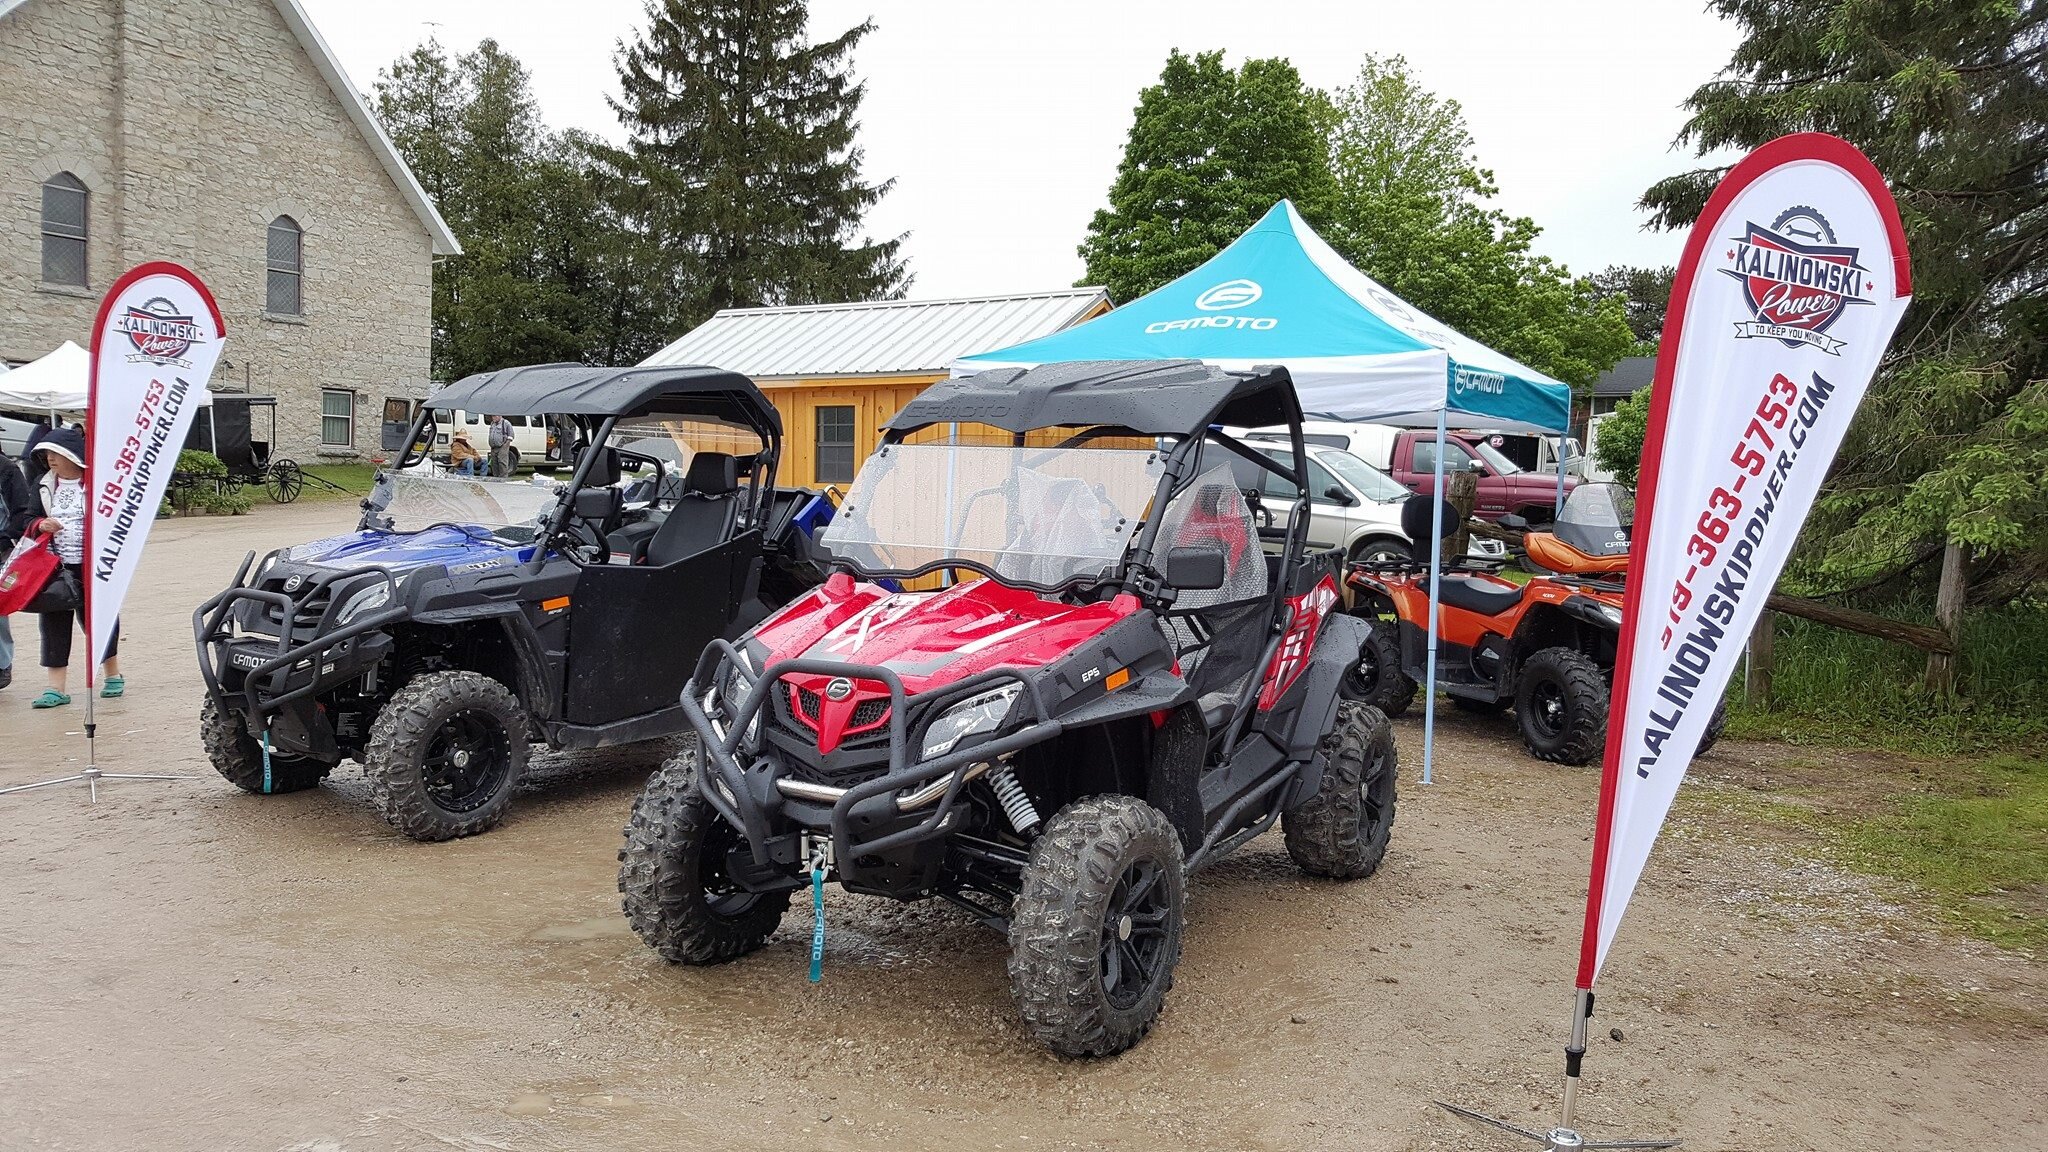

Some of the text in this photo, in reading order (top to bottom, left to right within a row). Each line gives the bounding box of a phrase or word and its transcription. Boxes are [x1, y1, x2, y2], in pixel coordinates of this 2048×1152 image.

[1735, 243, 1861, 297] KALINOWSKI
[1755, 283, 1836, 322] Power
[123, 316, 197, 340] KALINOWSKI
[1144, 315, 1278, 334] CFMOTO
[1755, 325, 1823, 345] TO KEEP YOU MOVING
[140, 335, 186, 352] Power
[1465, 370, 1505, 394] CFMOTO
[97, 378, 165, 518] 519-363-5753
[95, 376, 190, 582] KALINOWSKIPOWER.COM
[233, 653, 270, 668] CFMOT
[1081, 666, 1100, 683] EPS
[812, 908, 825, 961] CFMOTO
